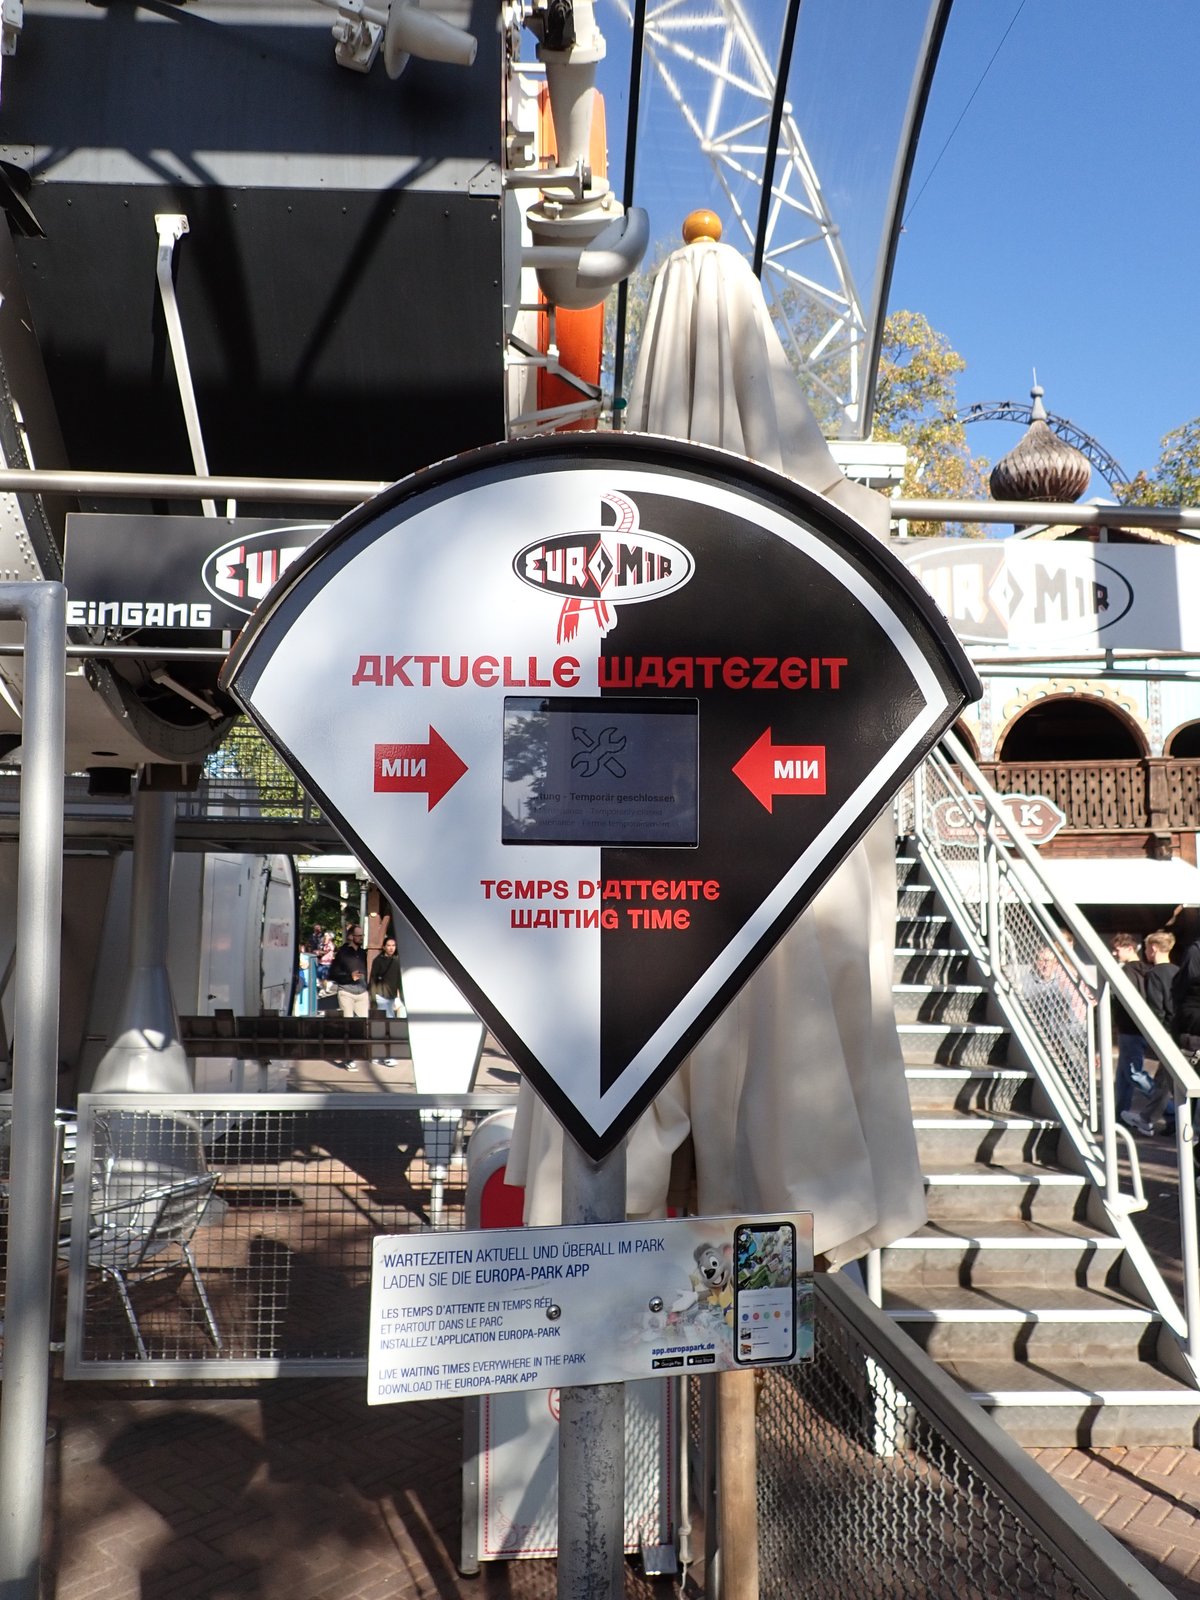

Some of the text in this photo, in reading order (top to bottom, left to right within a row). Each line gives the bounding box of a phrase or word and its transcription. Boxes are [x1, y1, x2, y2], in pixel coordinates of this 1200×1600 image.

[570, 792, 614, 803] Temporär
[617, 793, 675, 803] geschlossen
[384, 1238, 664, 1267] WARTEZEITEN AKTUELL UND ÜBERALL IM PARK
[383, 1263, 590, 1289] LADEN SIE DIE EUROPA-PARK APP
[381, 1296, 553, 1319] LES TEMPS D'ATTENTE EN TEMPS RÉEL
[380, 1316, 503, 1334] ET PARTOUT DANS LE PARC
[380, 1327, 561, 1350] INSTALLEZ L'APPLICATION EUROPA-PARK
[652, 1343, 715, 1355] app.europapark.de
[379, 1353, 586, 1380] LIVE WAITING TIMES EVERYWHERE IN THE PARK
[378, 1371, 538, 1395] DOWNLOAD THE EUROPA-PARK APP
